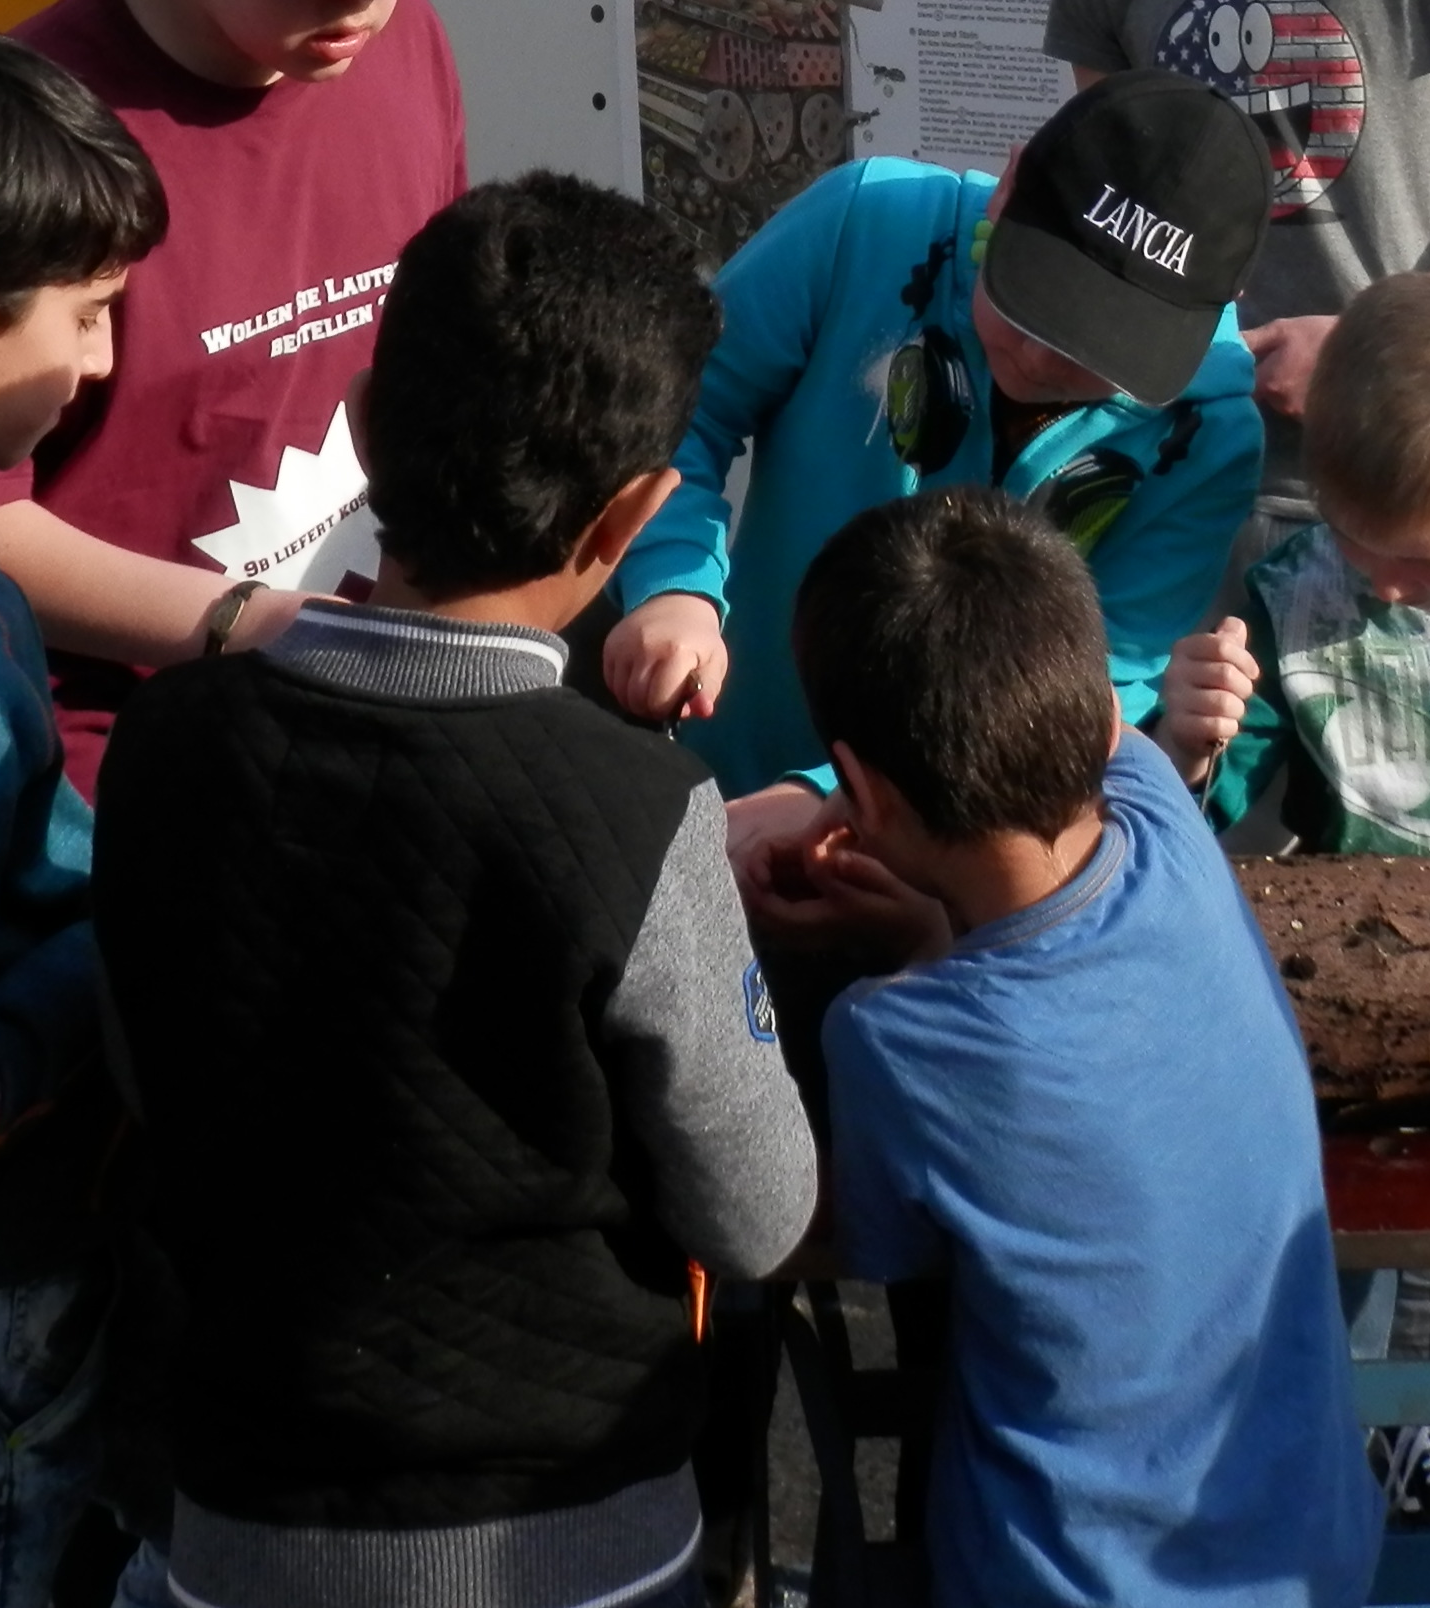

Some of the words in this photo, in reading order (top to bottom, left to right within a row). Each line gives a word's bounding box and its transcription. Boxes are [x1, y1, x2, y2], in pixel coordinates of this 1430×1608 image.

[1082, 183, 1195, 277] LANCIA
[324, 261, 400, 303] LAUTS
[274, 514, 335, 564] LIEFERT
